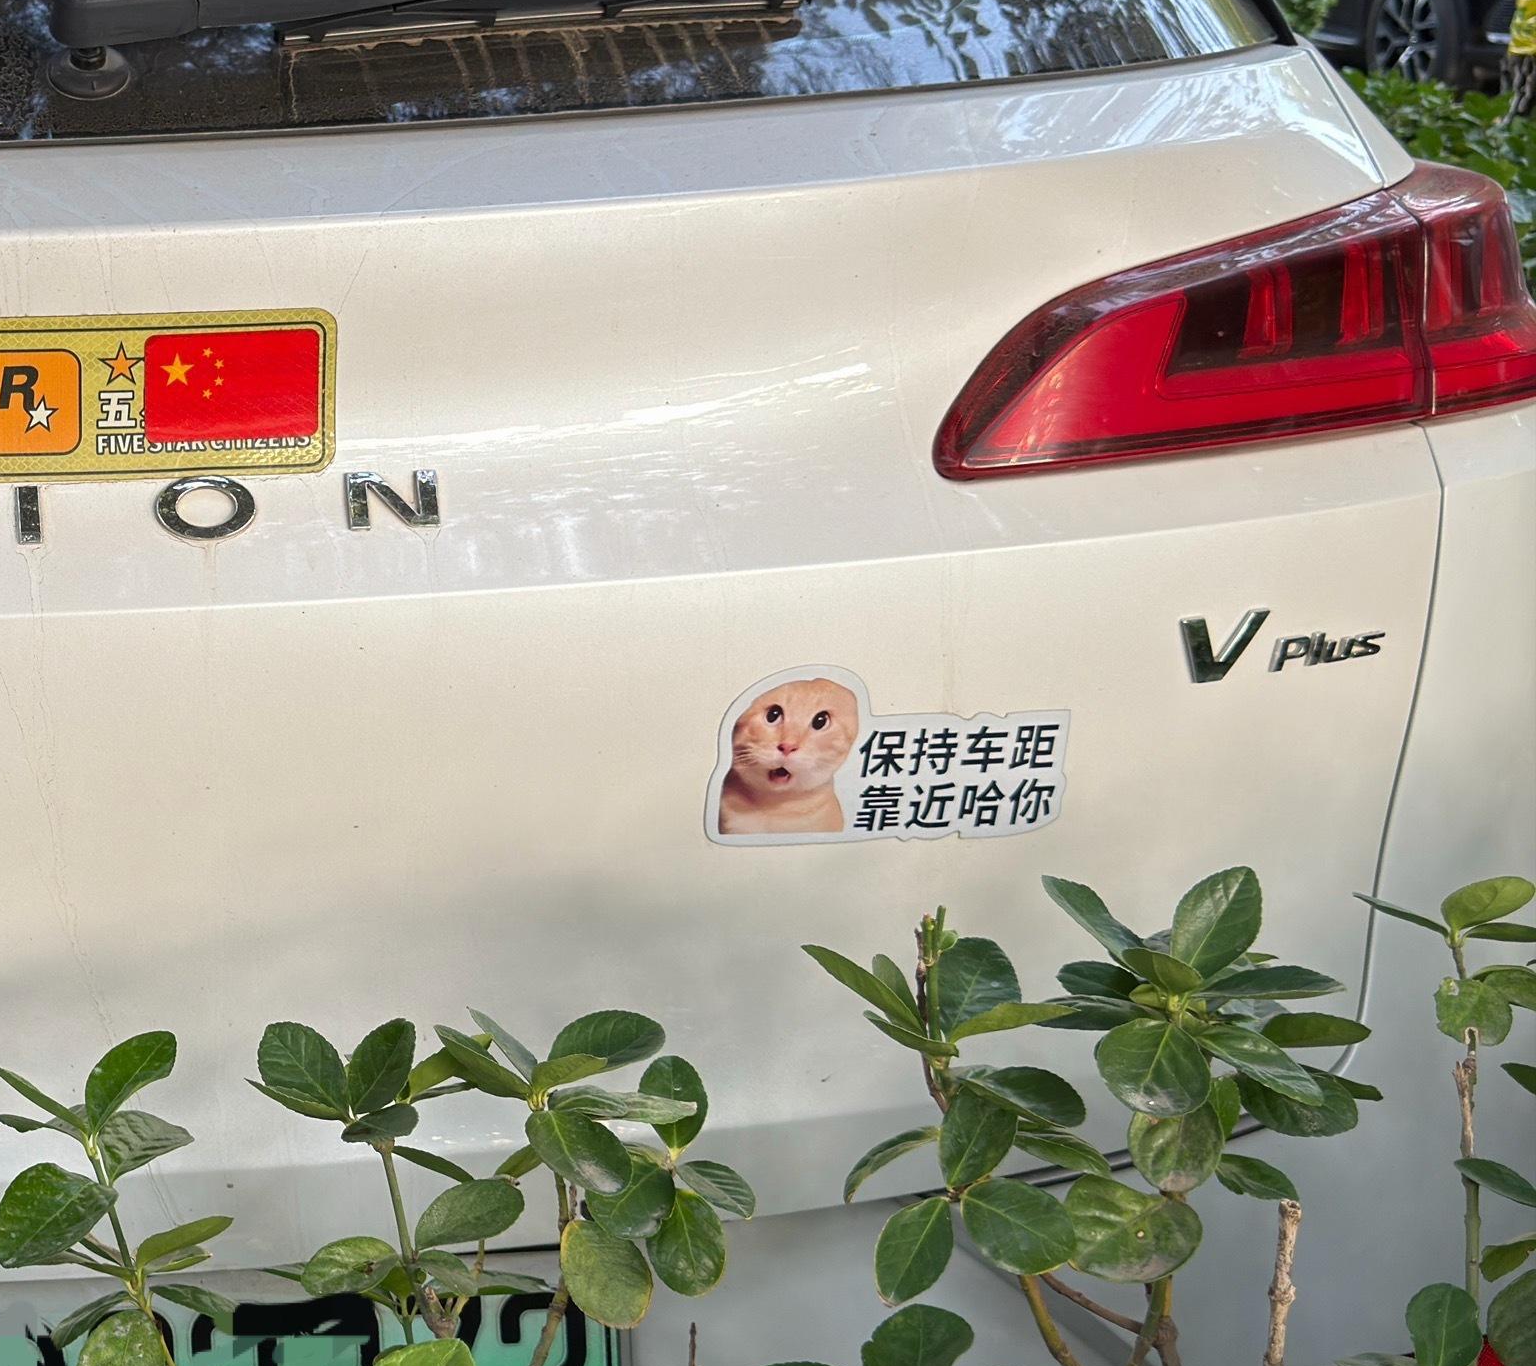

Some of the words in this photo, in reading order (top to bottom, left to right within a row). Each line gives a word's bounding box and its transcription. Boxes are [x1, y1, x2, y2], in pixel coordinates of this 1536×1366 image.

[96, 390, 145, 430] 五
[96, 434, 145, 455] FIVE
[1179, 608, 1271, 684] V
[1267, 630, 1386, 673] Plus
[859, 724, 1060, 778] 保持车距
[853, 778, 1056, 831] 靠近哈你
